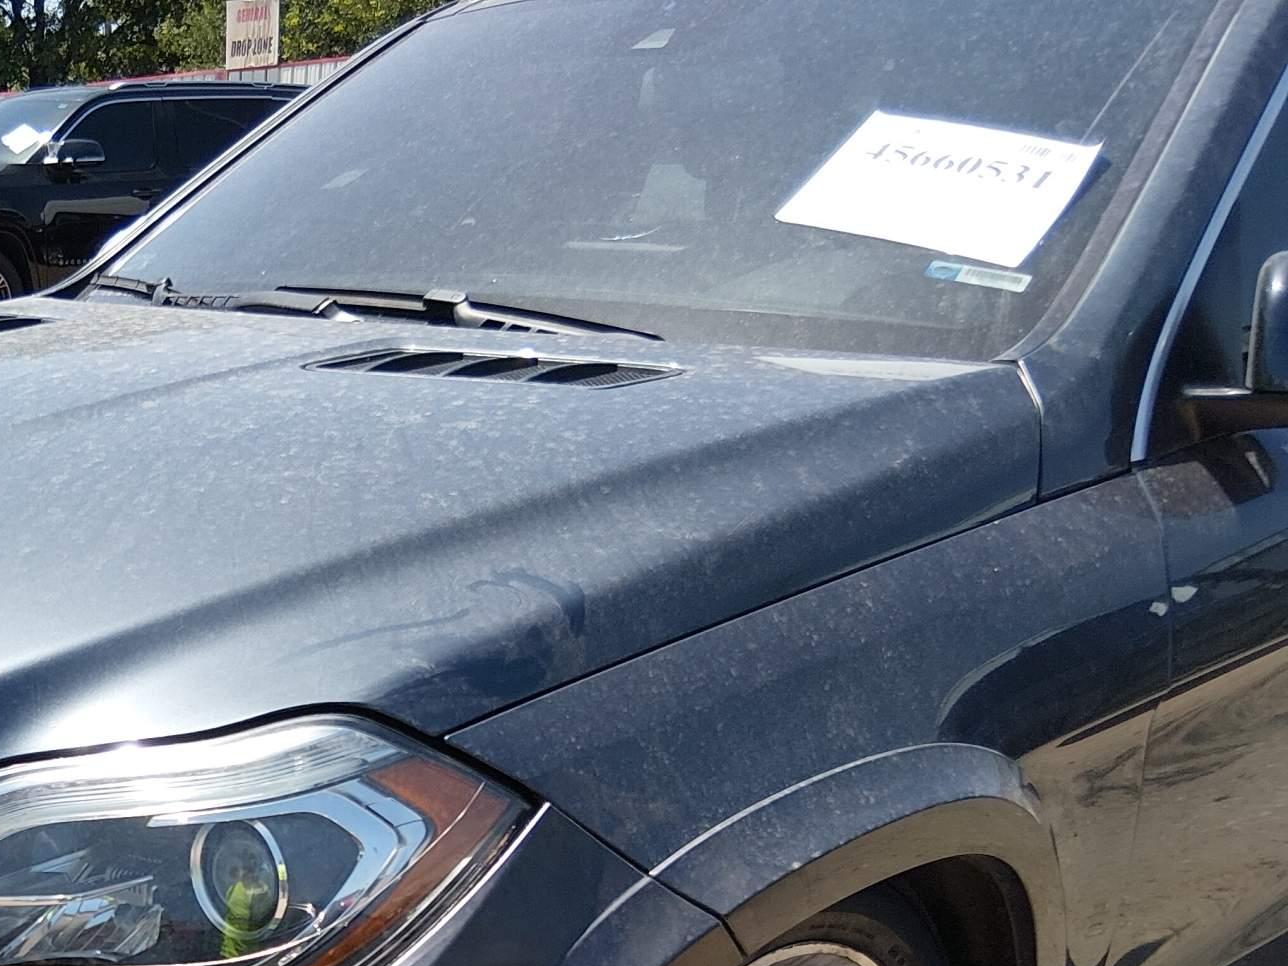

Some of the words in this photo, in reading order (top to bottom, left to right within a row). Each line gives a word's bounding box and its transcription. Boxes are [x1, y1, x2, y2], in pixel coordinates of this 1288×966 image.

[231, 39, 252, 58] DROP
[252, 36, 273, 56] ZONE
[866, 143, 1053, 188] 45660531
